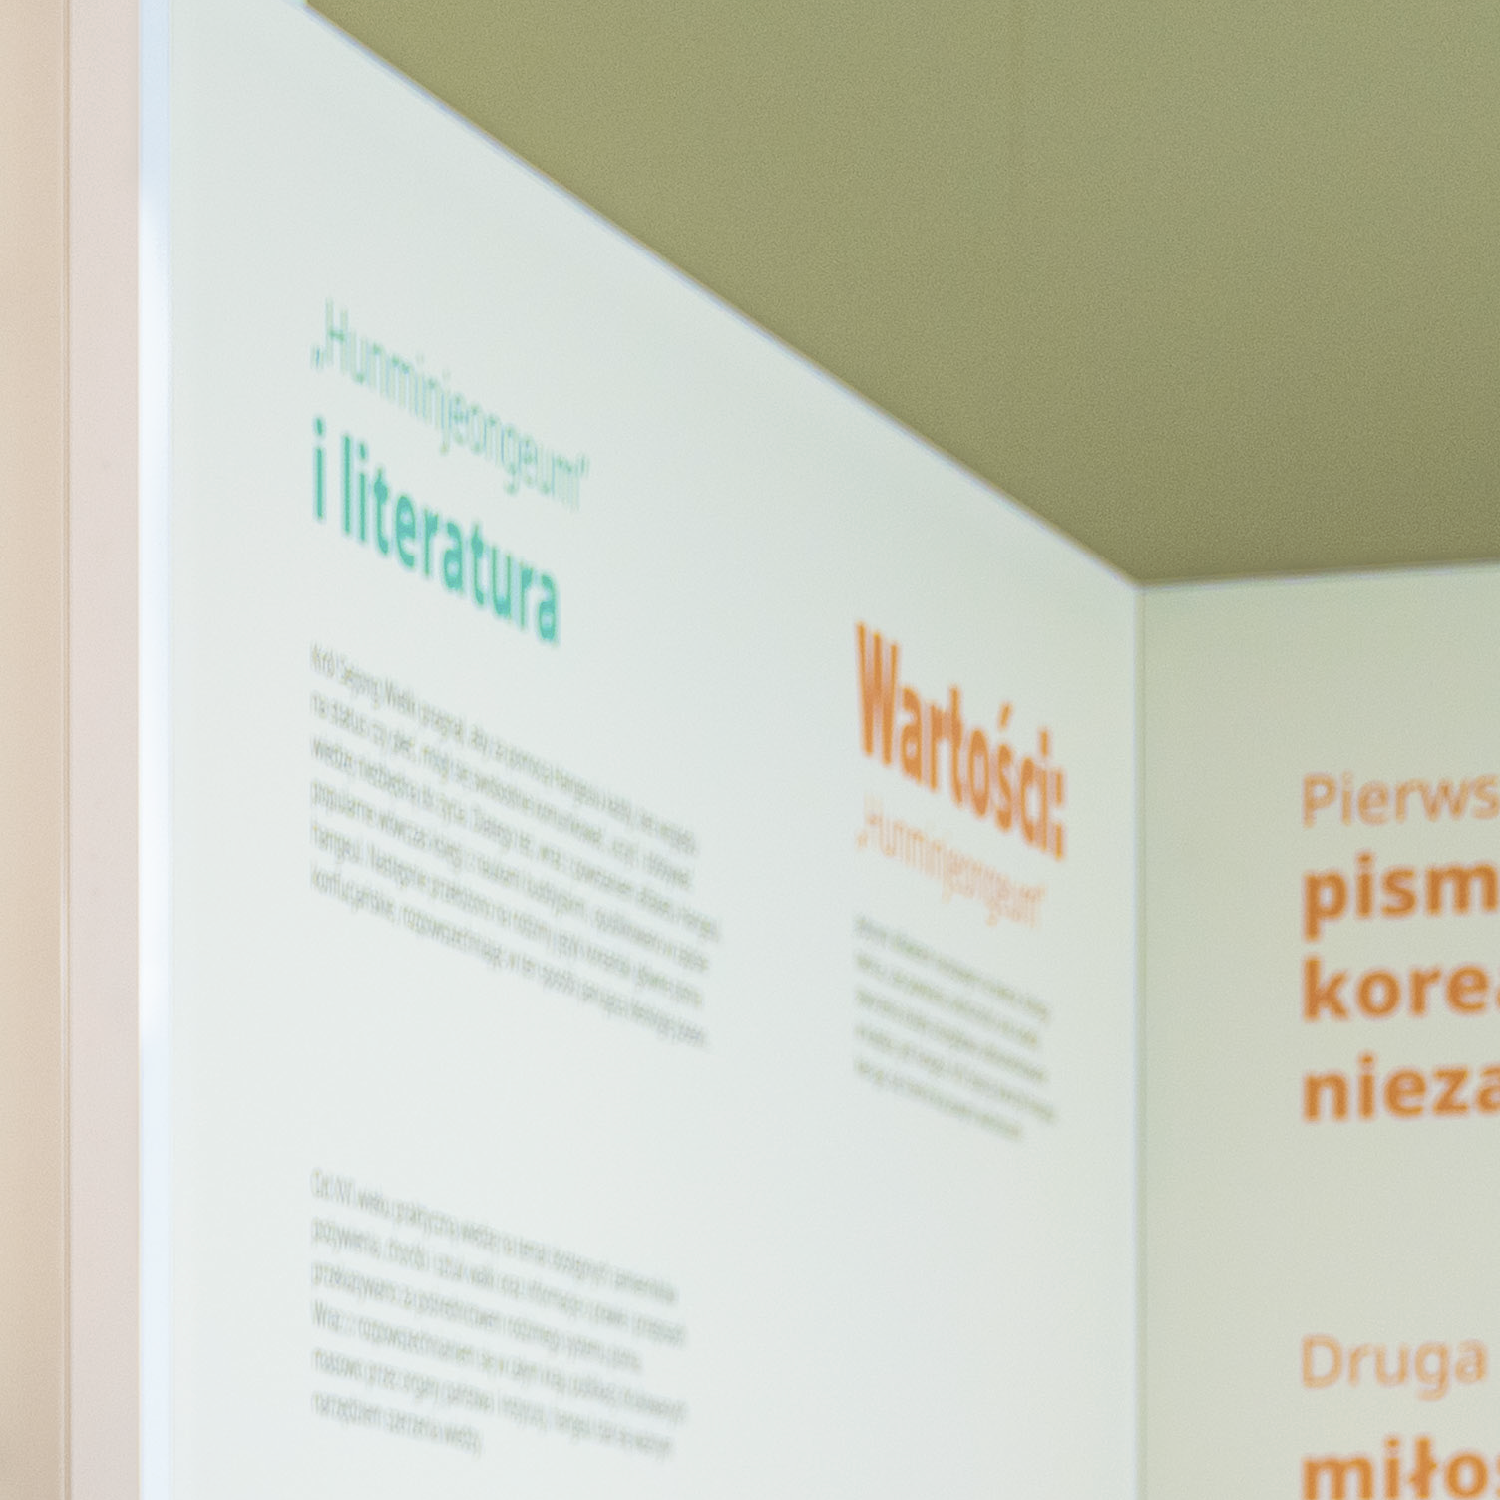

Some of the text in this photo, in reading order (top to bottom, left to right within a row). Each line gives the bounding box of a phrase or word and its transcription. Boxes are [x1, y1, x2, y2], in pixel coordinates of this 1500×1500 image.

[312, 416, 562, 647] i literatura
[855, 620, 1065, 862] Wartości:
[1302, 1334, 1488, 1401] Druga
